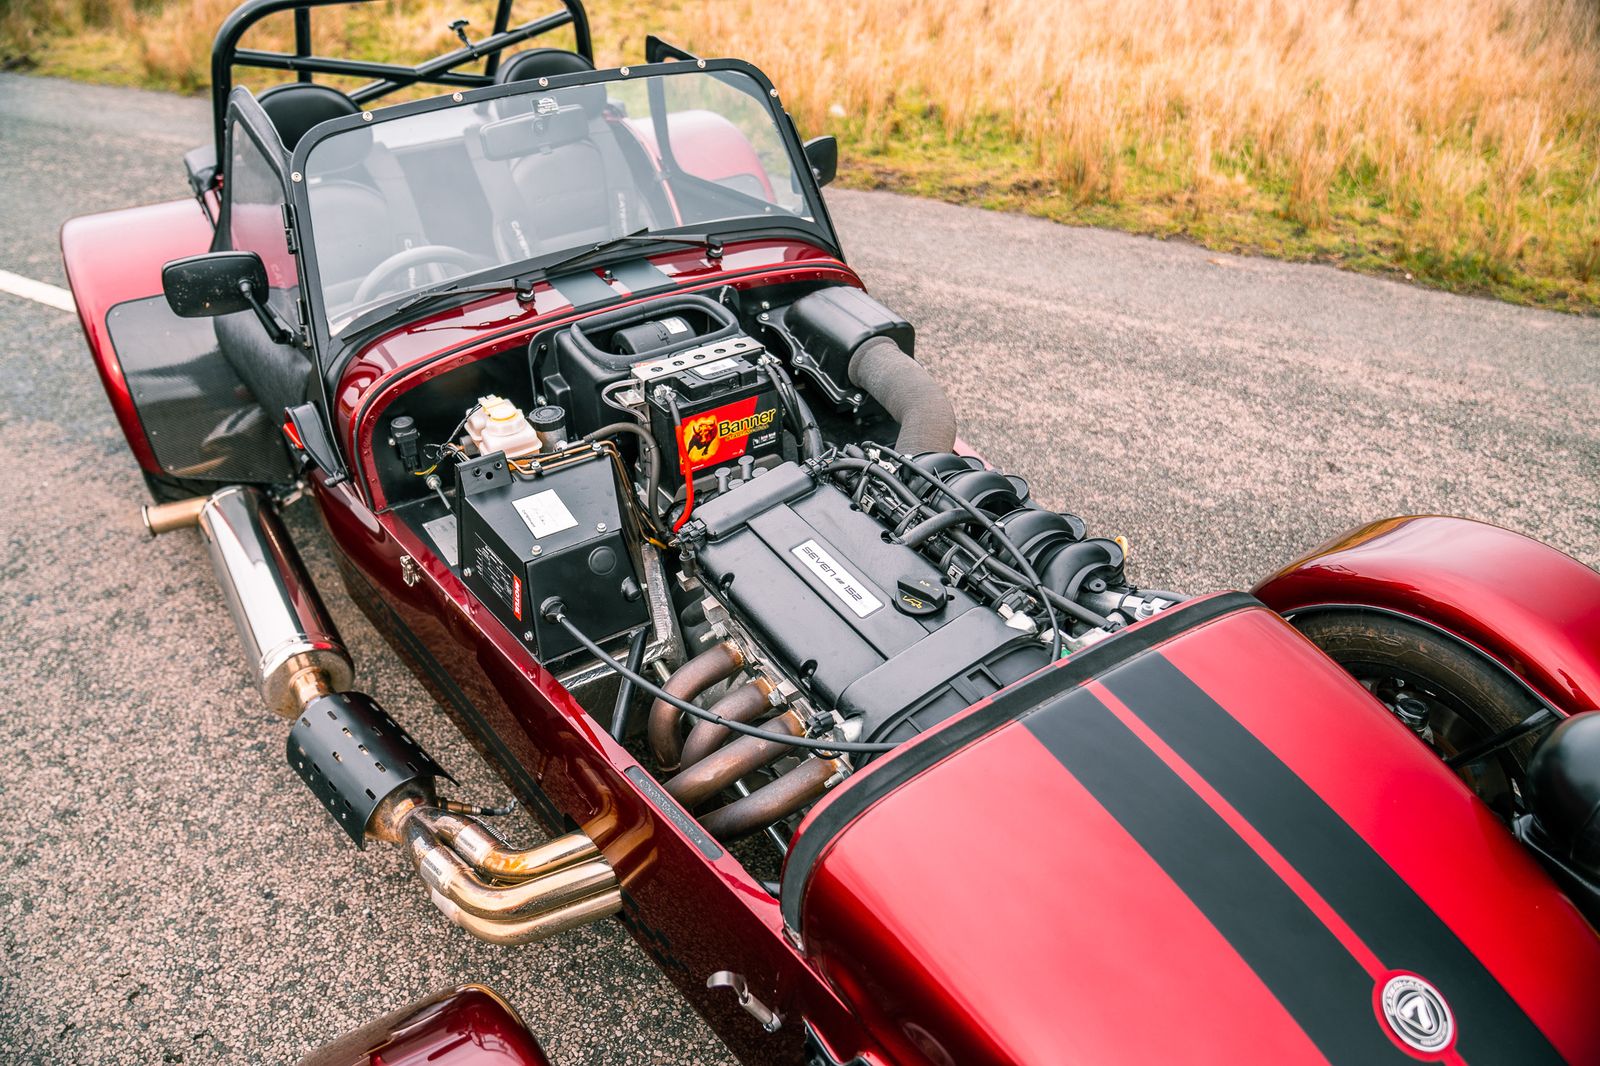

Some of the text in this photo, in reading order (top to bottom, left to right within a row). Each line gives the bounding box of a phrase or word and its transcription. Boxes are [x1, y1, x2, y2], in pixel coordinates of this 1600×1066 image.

[718, 408, 776, 437] Banner
[801, 546, 863, 602] SEVEN 152
[1400, 995, 1433, 1031] 7
